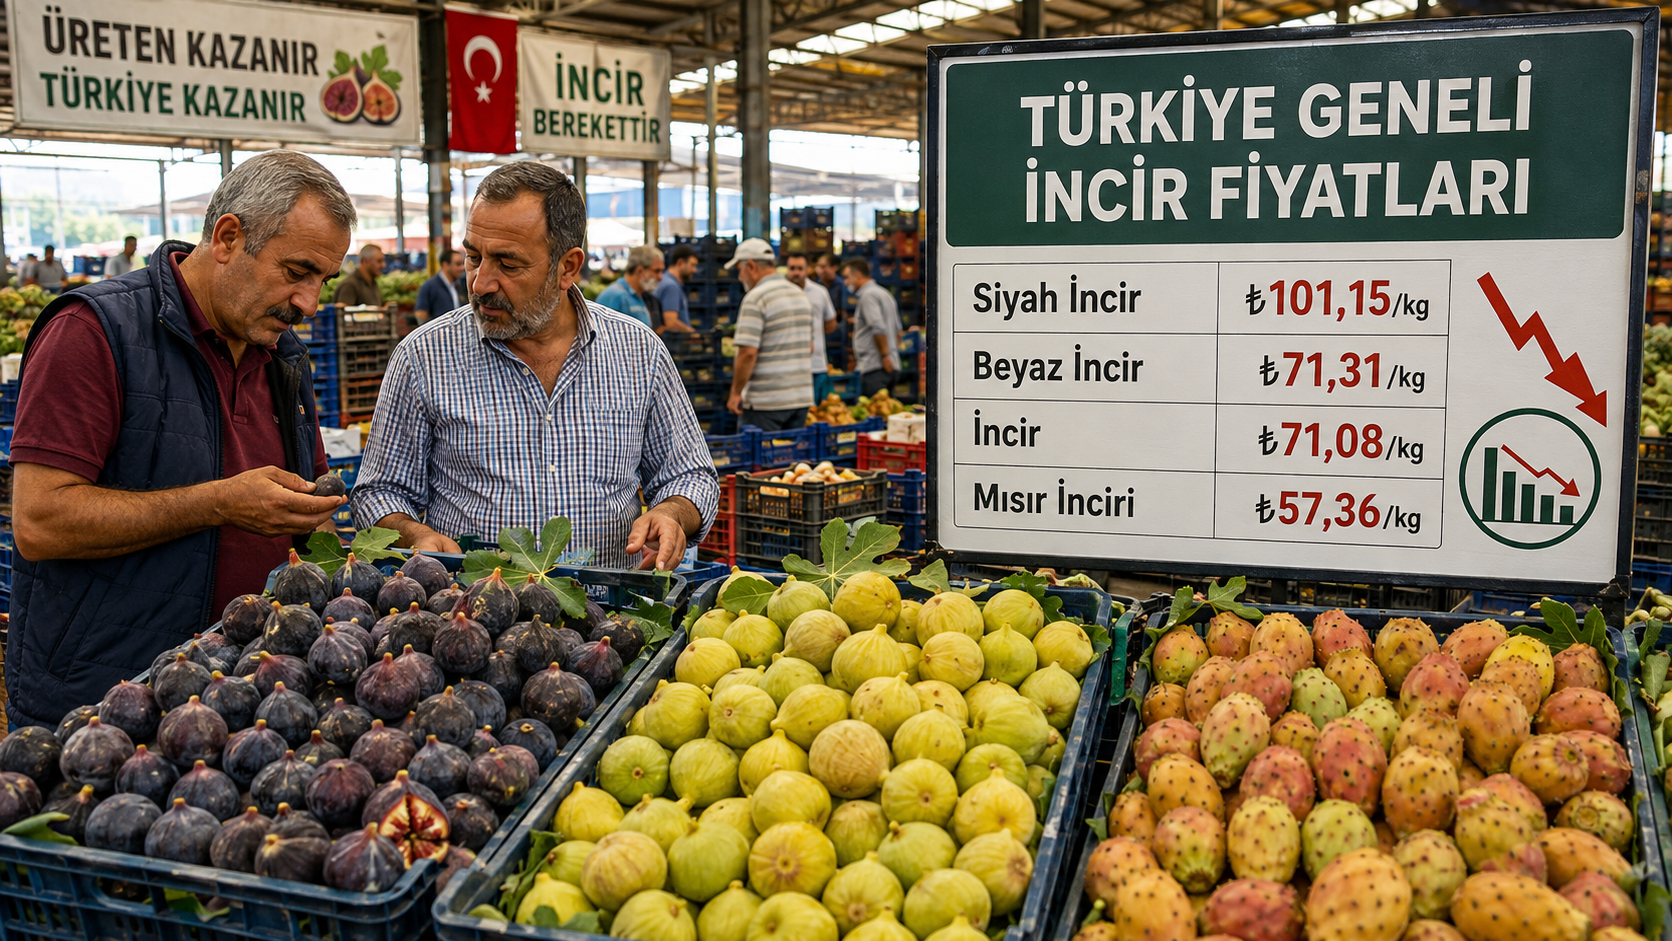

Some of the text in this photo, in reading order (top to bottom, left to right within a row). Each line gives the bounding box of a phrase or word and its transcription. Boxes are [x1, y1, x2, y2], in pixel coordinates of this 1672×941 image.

[42, 8, 319, 76] ÜRETEN KAZANIR
[39, 66, 306, 123] TÜRKİYE KAZANIR
[556, 52, 644, 107] İNCİR
[1020, 60, 1532, 147] TÜRKİYE GENELİ
[533, 108, 662, 145] BEREKETTİR
[1026, 151, 1530, 223] İNCİR FİYATLARI
[973, 274, 1430, 322] Siyah İncir ₺101,15/kg
[973, 343, 1426, 394] Beyaz İncir ₺71,31/kg
[974, 408, 1424, 465] İncir ₺71,08/kg
[974, 477, 1422, 535] Mısır İnciri ₺57,36/kg
